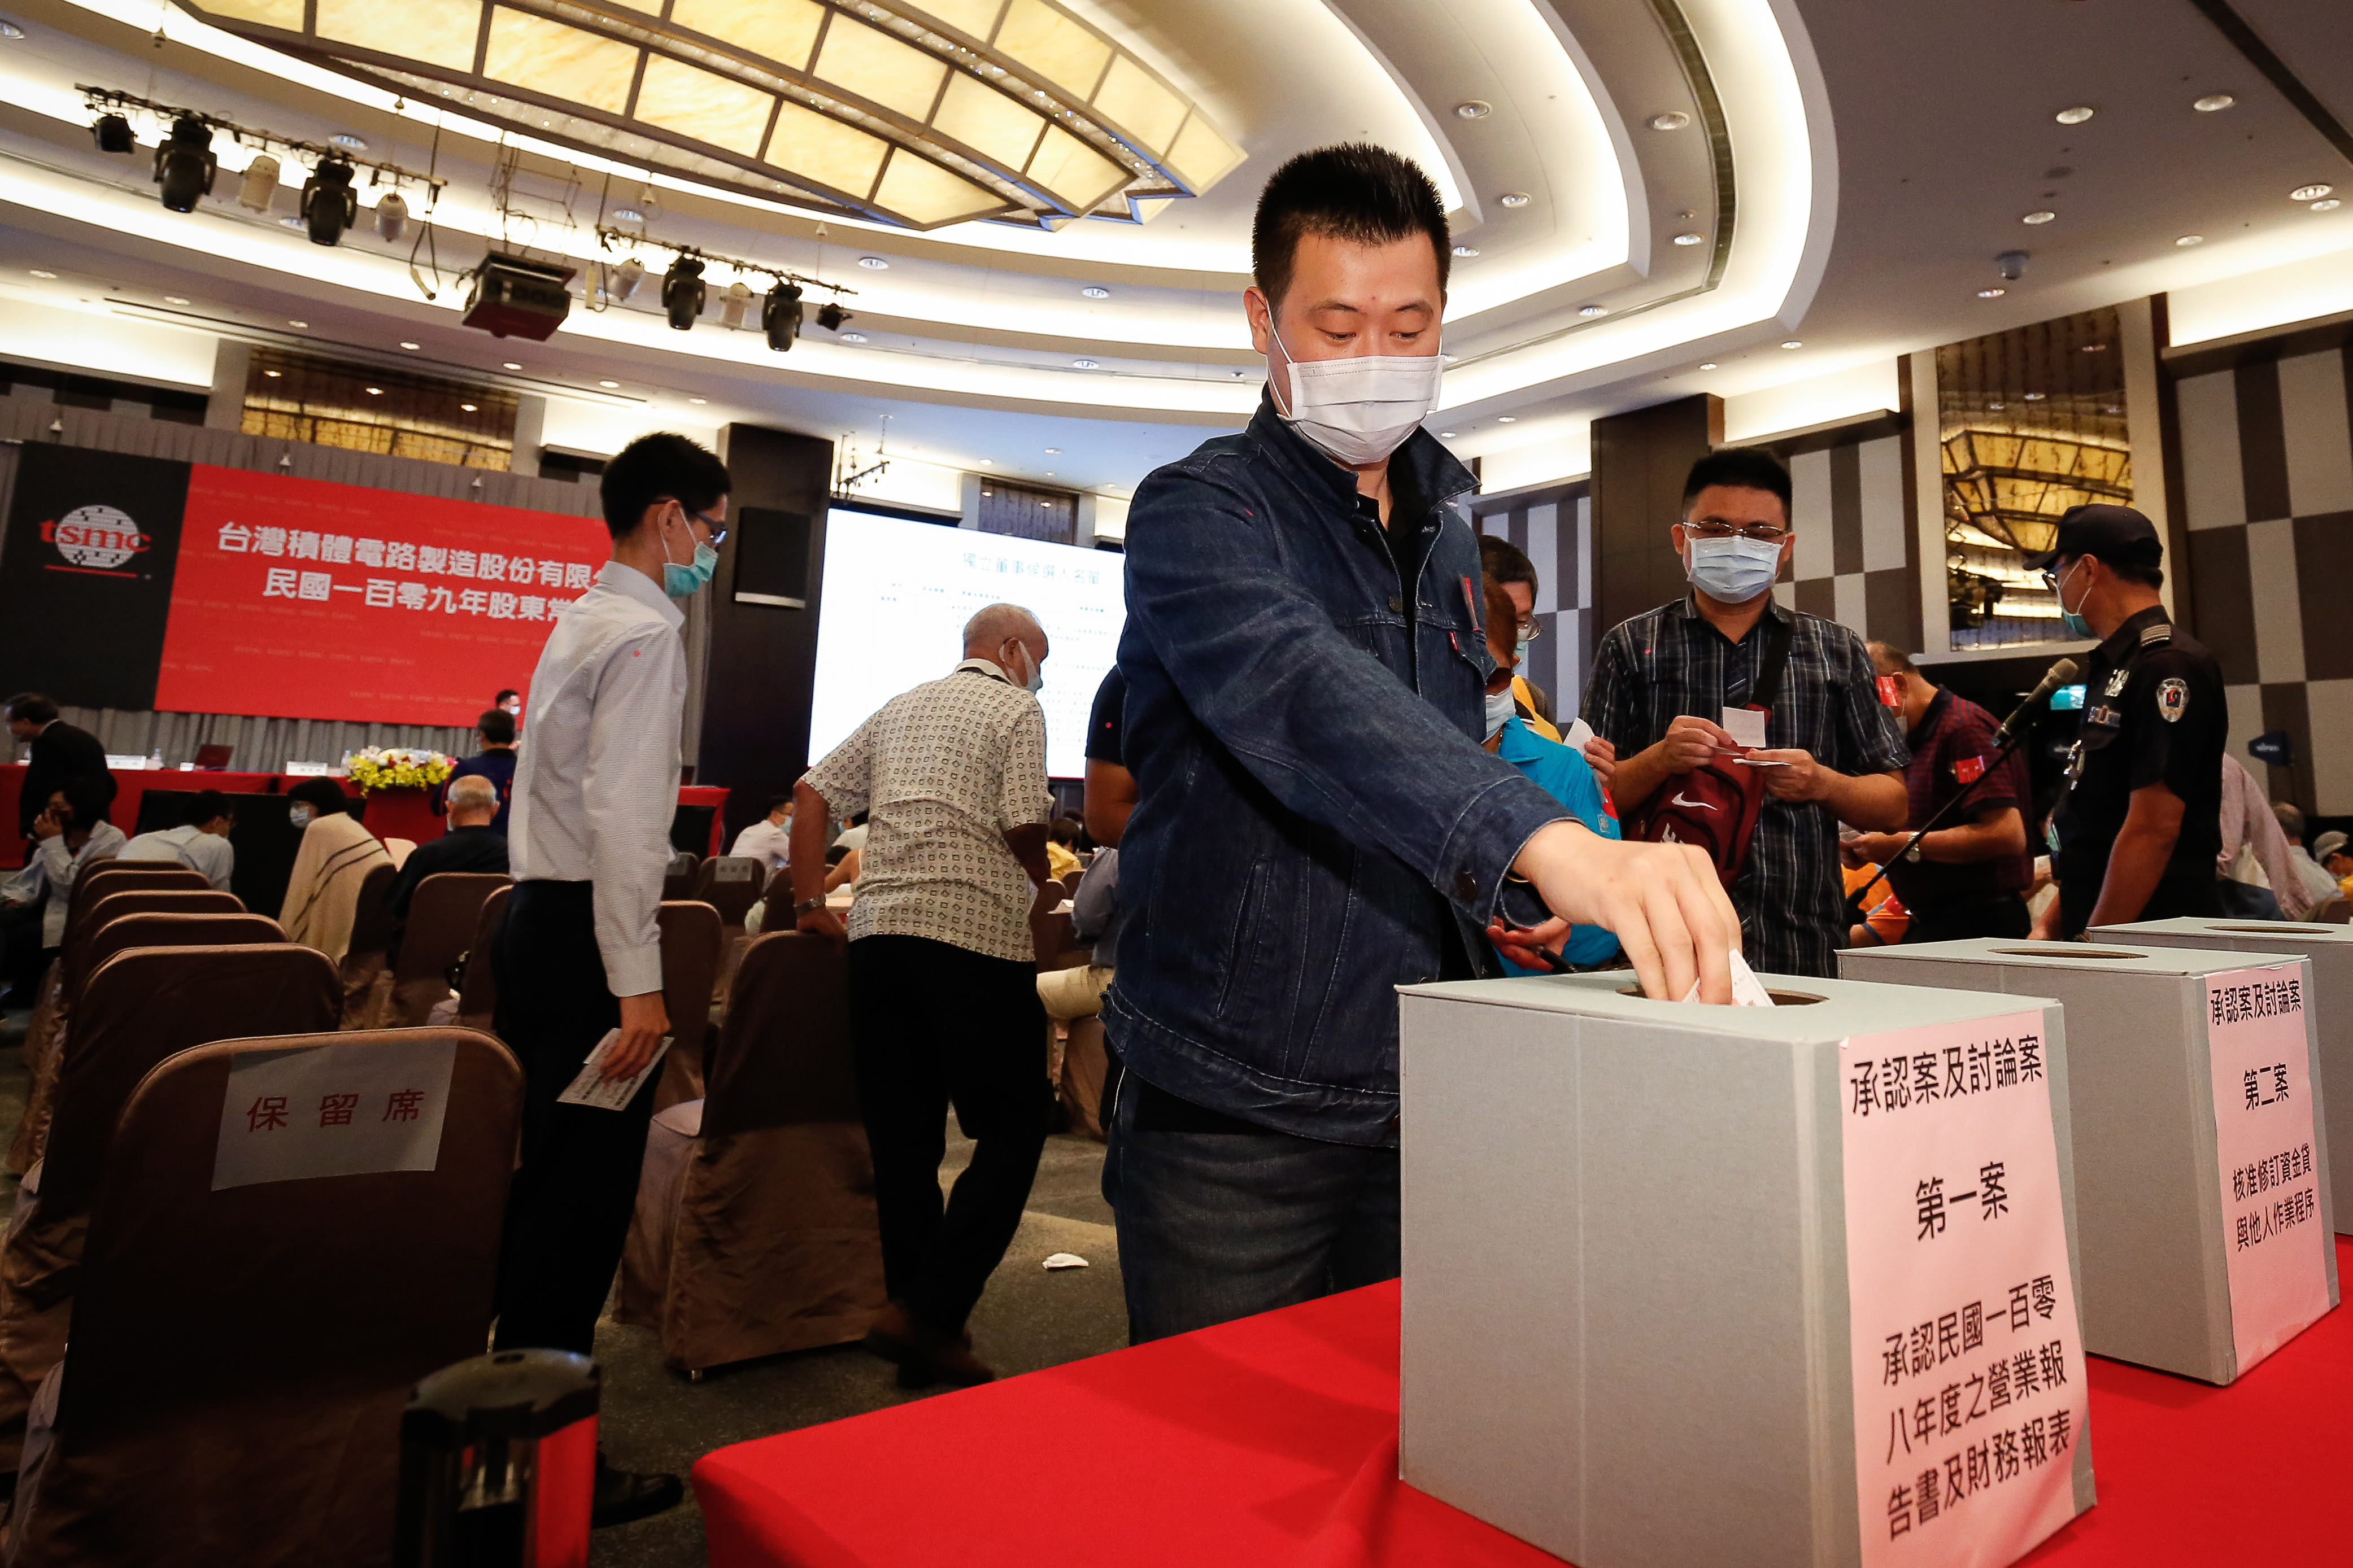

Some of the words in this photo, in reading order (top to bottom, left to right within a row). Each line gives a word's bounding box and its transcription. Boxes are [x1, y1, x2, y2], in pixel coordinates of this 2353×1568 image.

[40, 518, 151, 553] tsmc
[217, 521, 603, 590] 台灣積體電路製造股份有限
[963, 552, 1100, 584] 獨立董事候選人名單
[2211, 979, 2302, 1026] 承認案及討論案
[1850, 1034, 2042, 1117] 承認案及討論案
[2243, 1063, 2289, 1111] 第二案
[246, 1088, 425, 1133] 保留席
[1915, 1160, 2009, 1242] 第一案
[2233, 1142, 2312, 1203] 核准修訂資金貸
[2236, 1187, 2314, 1252] 與他人作業程序
[1882, 1274, 2056, 1387] 承認民國一百零
[1886, 1339, 2068, 1465] 八年度之營業報
[1888, 1409, 2071, 1542] 告書及財務報表
